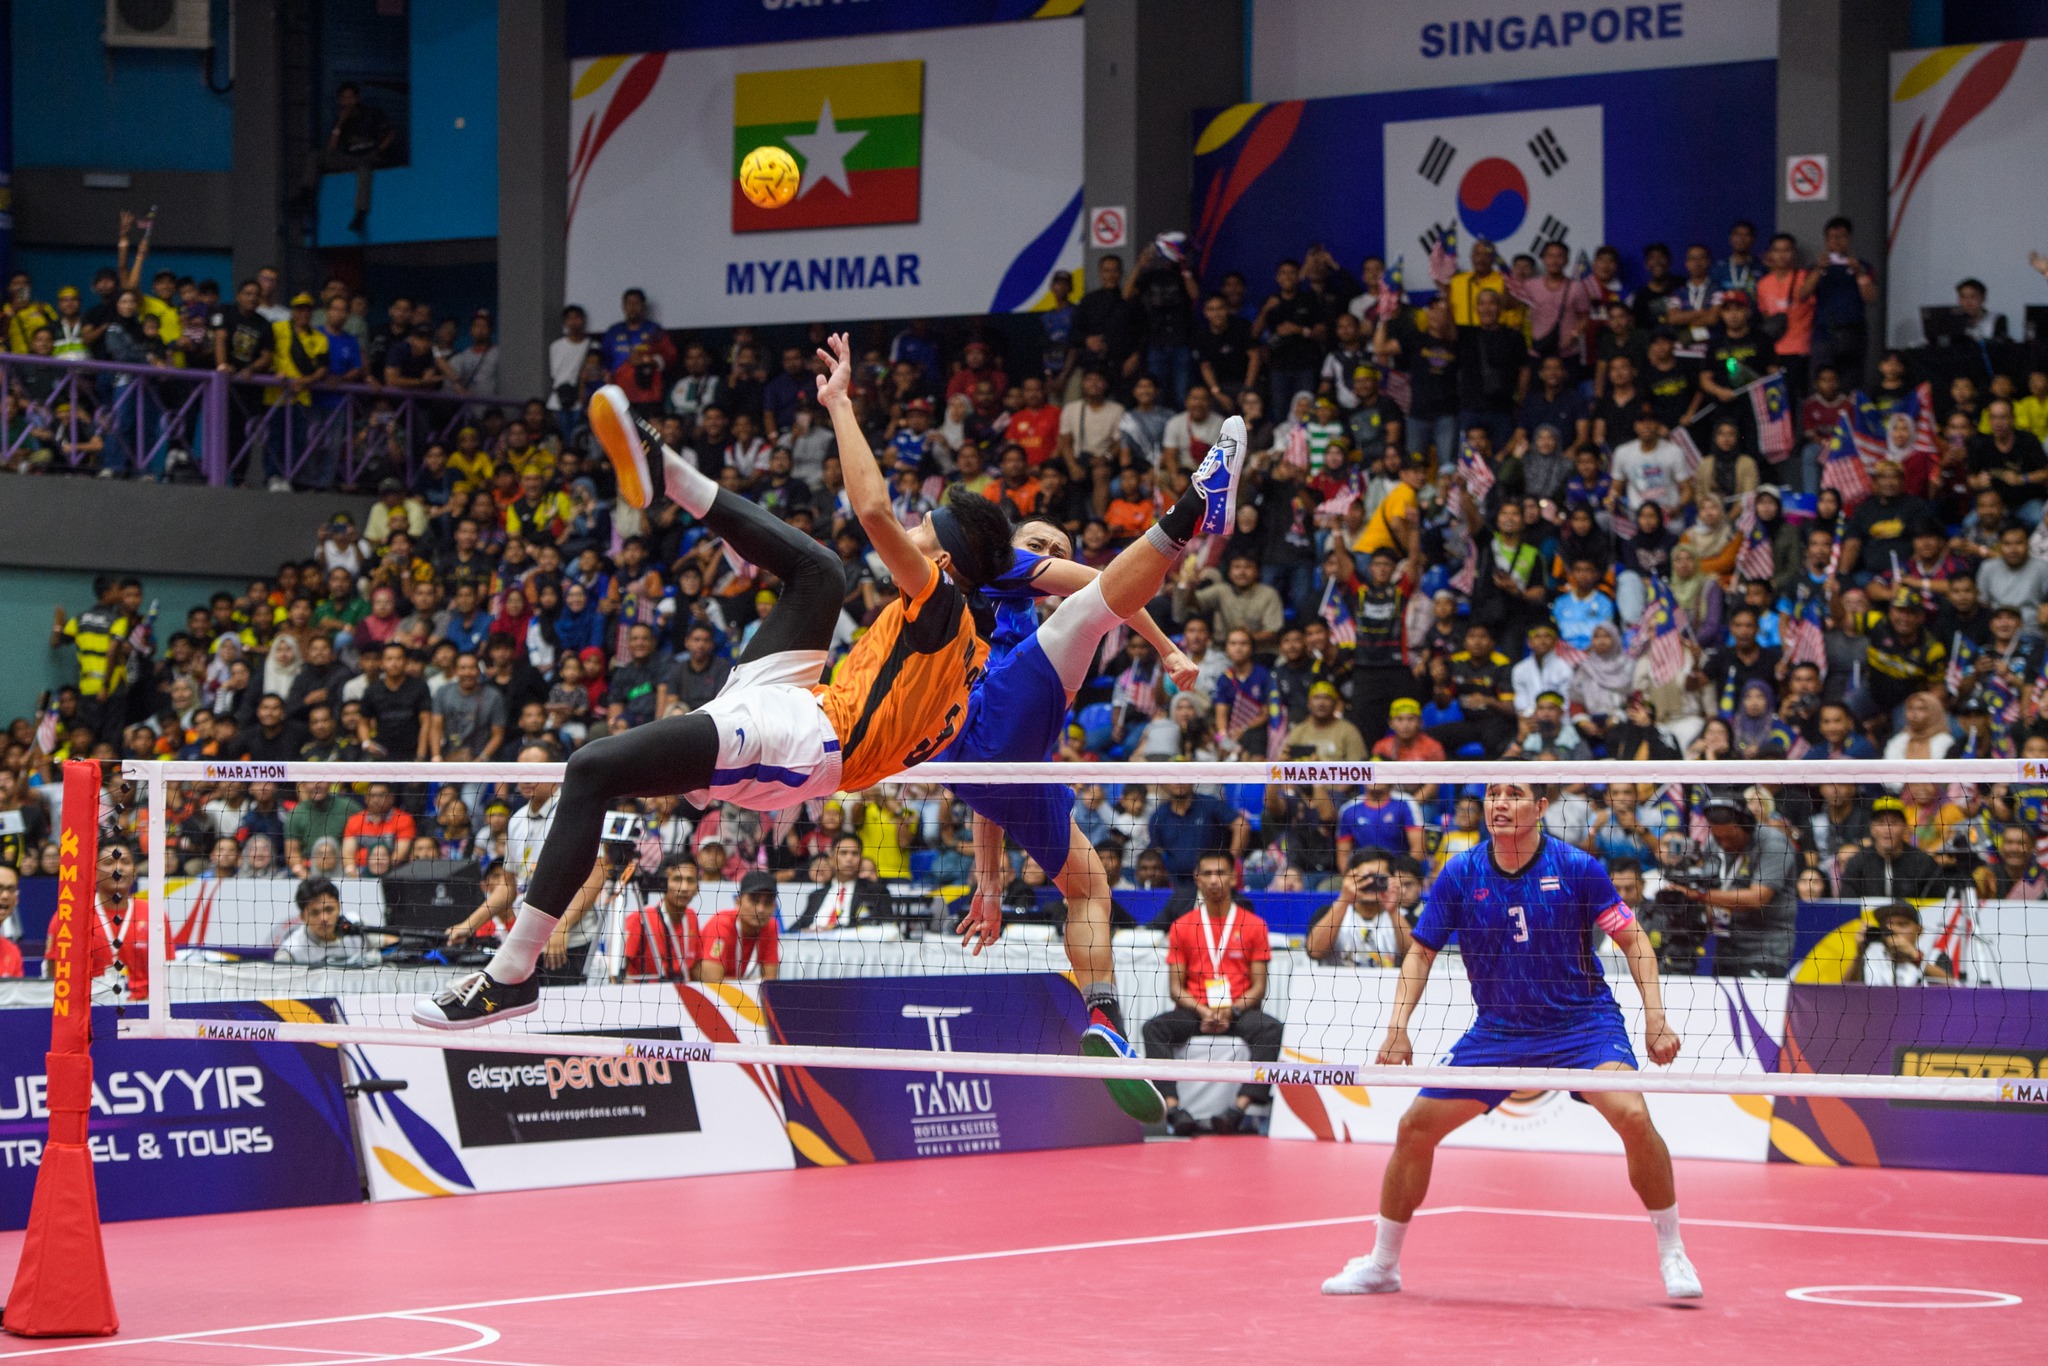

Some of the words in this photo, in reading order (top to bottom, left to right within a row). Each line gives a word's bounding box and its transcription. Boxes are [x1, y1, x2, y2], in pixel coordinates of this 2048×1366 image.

[1420, 3, 1683, 58] SINGAPORE
[726, 254, 920, 295] MYANMAR
[217, 766, 285, 779] MARATHON
[1284, 767, 1372, 781] MARATHON
[1508, 905, 1529, 943] 3
[54, 865, 78, 1016] MARATHON
[208, 1025, 276, 1040] MARATHON
[636, 1045, 711, 1062] MARATHON
[1268, 1069, 1355, 1085] MARATHON
[906, 1079, 993, 1116] TAMU
[2017, 1085, 2048, 1102] MA
[516, 1105, 646, 1123] www.ekspresperdana.com.my
[914, 1123, 949, 1138] HOTEL
[951, 1122, 959, 1135] &
[960, 1120, 998, 1135] SUITES
[0, 1134, 130, 1168] TREL
[138, 1133, 163, 1160] &
[168, 1126, 274, 1158] TOURS
